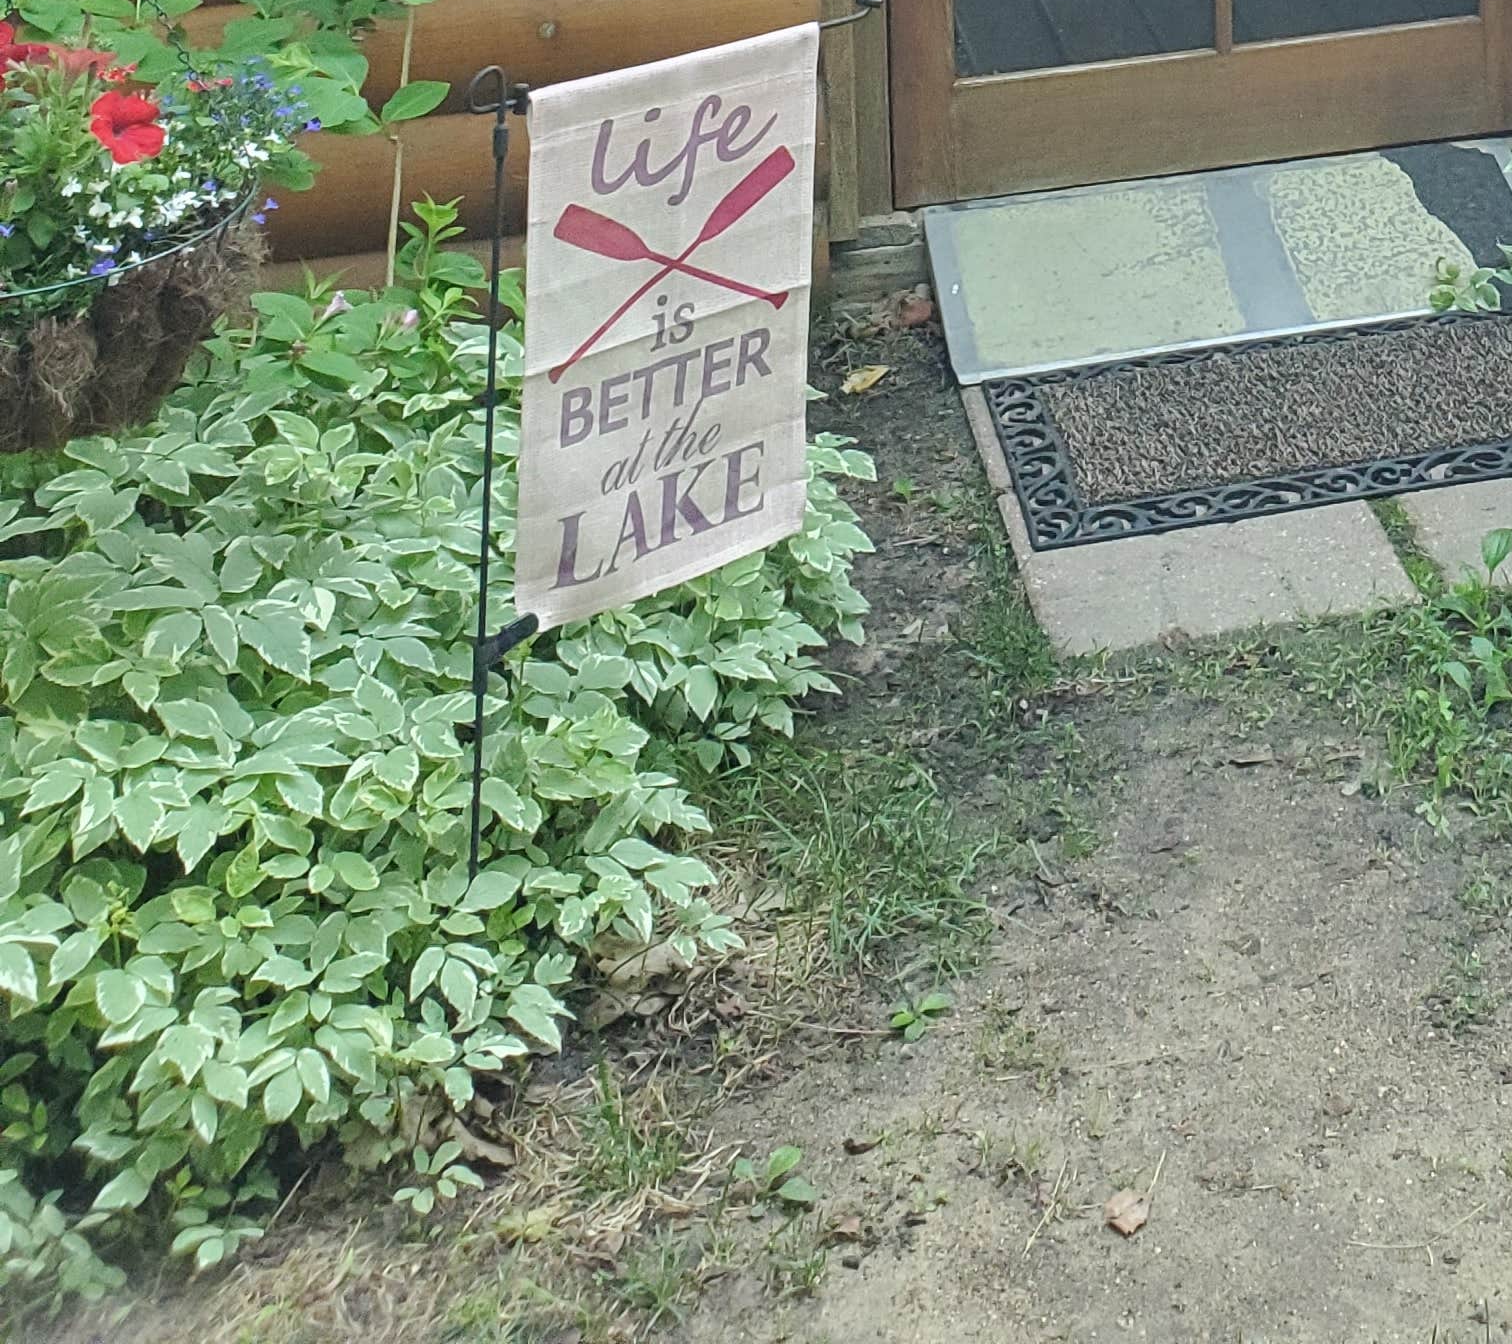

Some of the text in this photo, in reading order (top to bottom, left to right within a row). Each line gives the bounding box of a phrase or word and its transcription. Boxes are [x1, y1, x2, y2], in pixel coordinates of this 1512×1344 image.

[650, 295, 695, 352] is
[560, 327, 772, 449] BETTER
[601, 396, 721, 496] at the
[548, 440, 765, 590] LAKE
